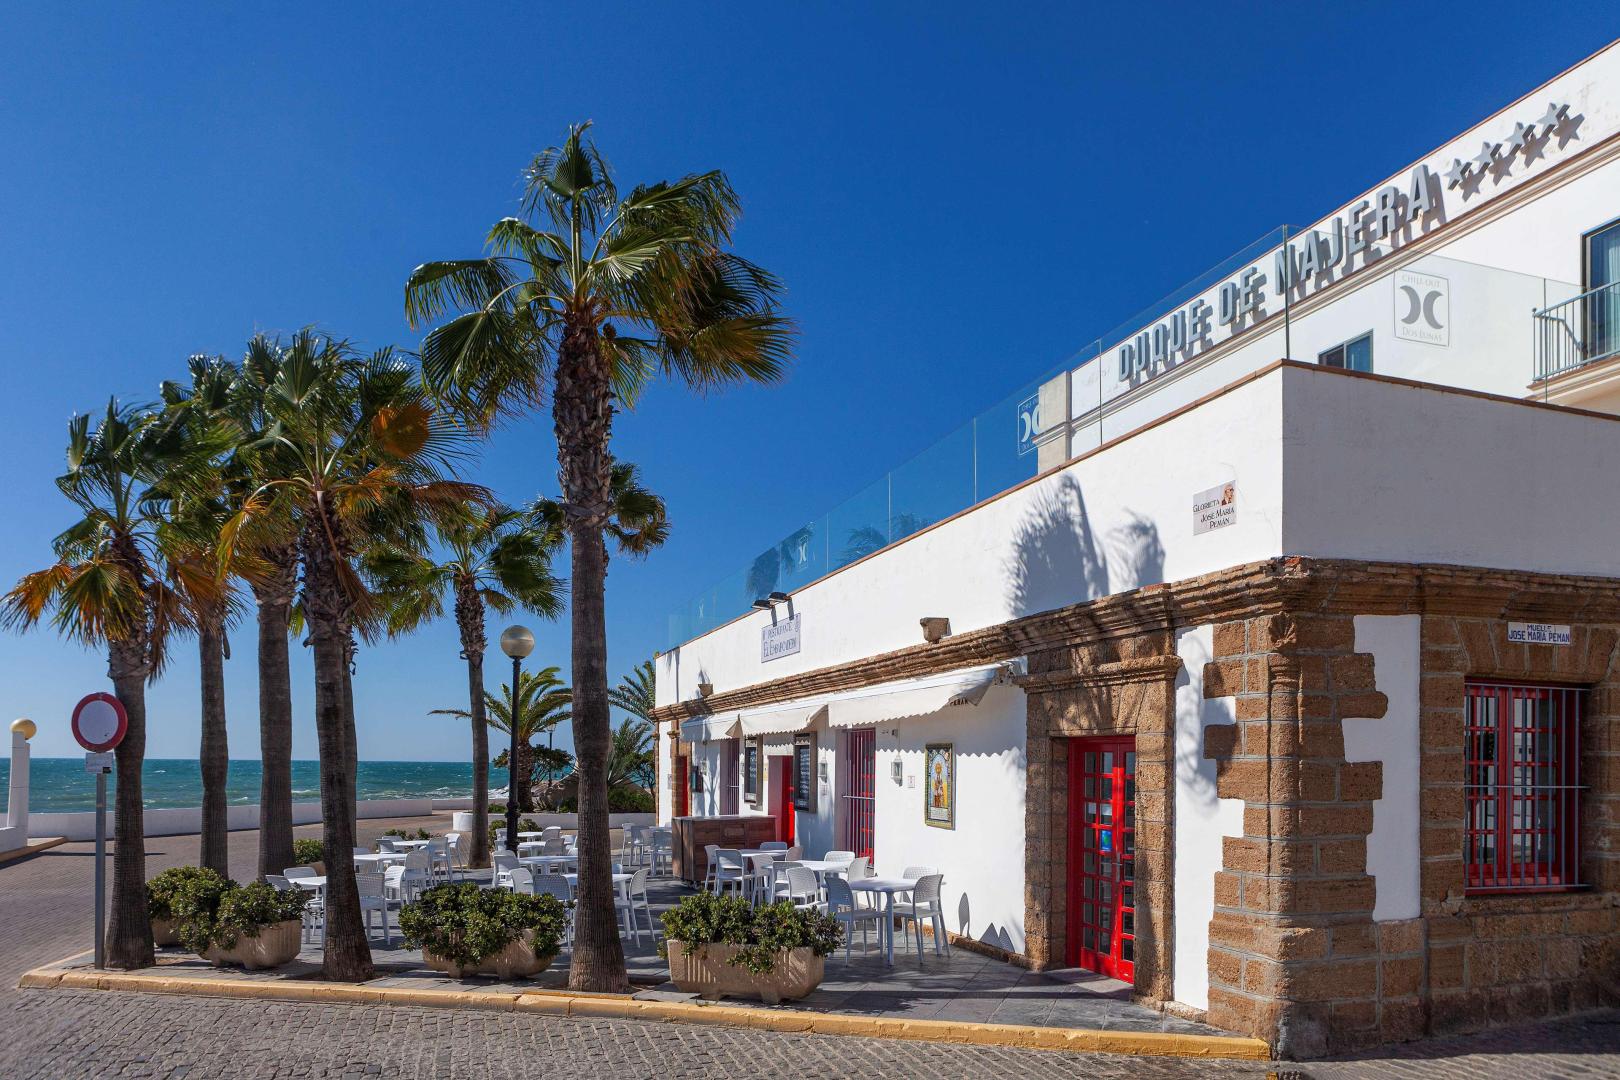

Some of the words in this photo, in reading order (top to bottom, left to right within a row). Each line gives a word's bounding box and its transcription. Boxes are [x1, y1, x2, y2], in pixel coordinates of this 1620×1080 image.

[1117, 298, 1205, 382] DUQUE
[1218, 265, 1258, 327] DE
[1274, 163, 1431, 296] NAJERA
[1192, 499, 1220, 513] GLORIETA
